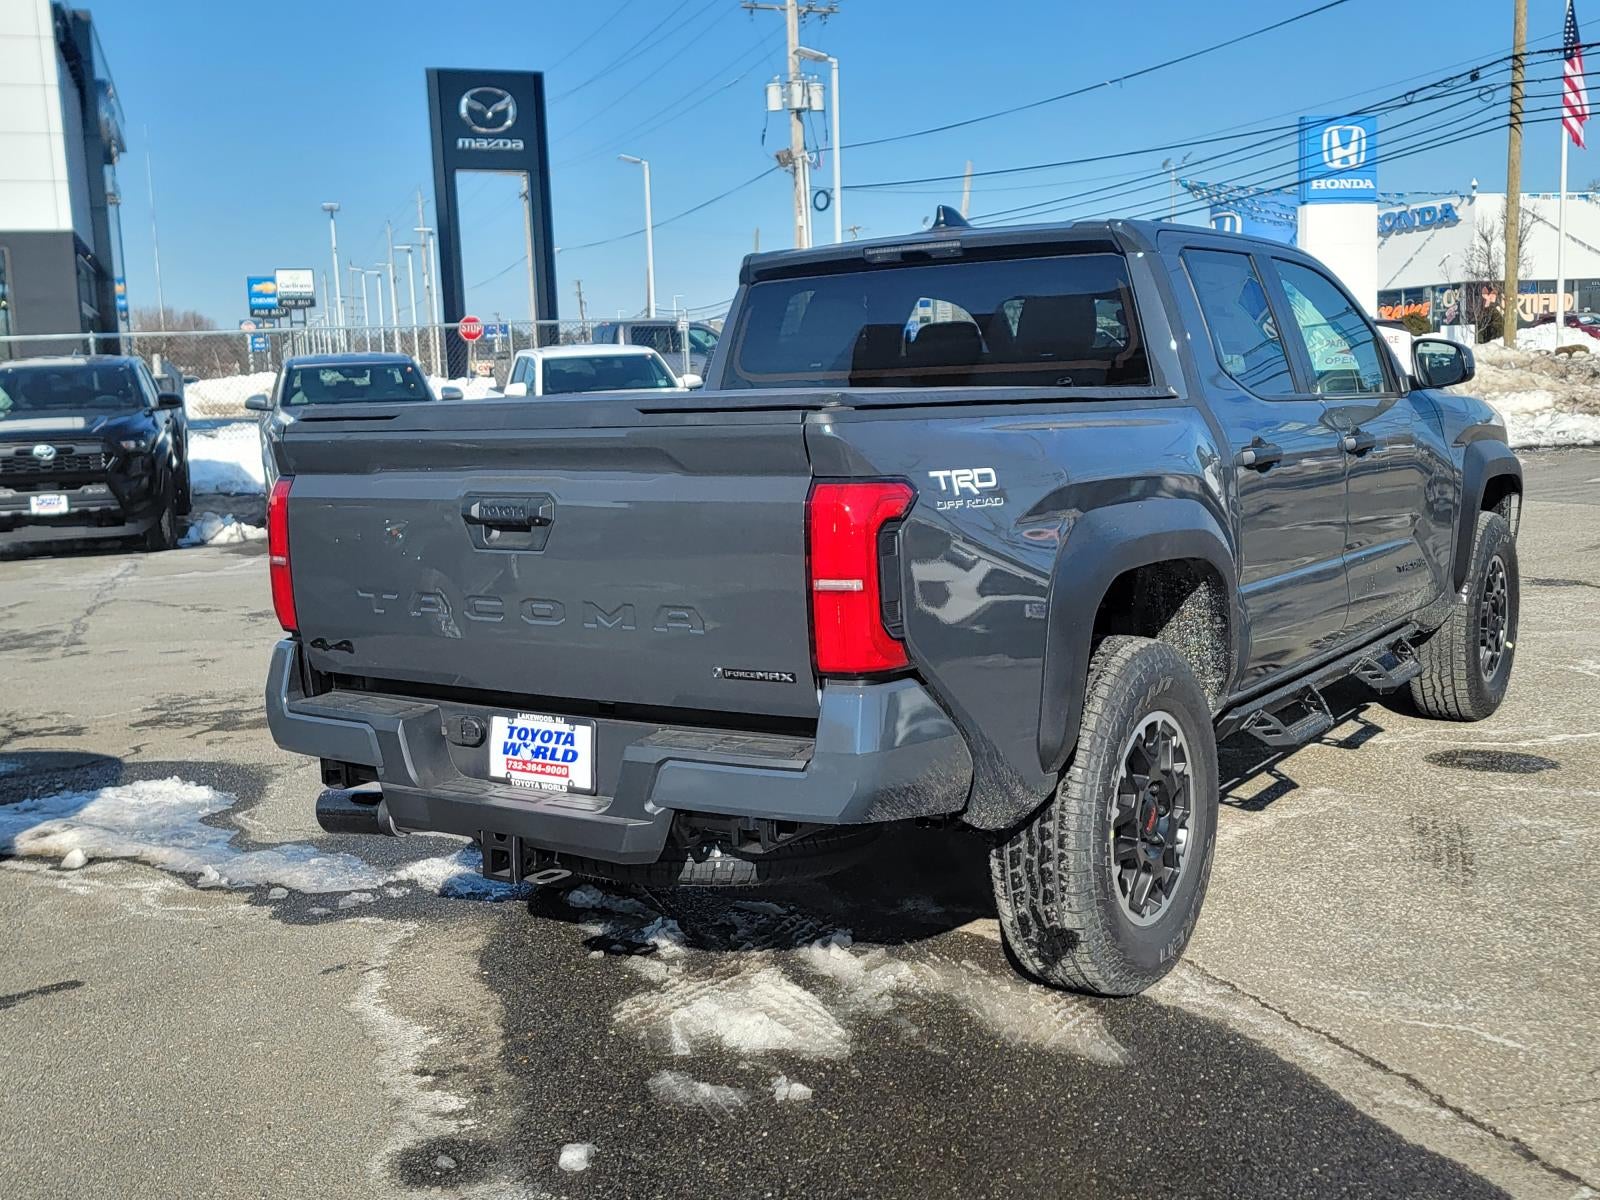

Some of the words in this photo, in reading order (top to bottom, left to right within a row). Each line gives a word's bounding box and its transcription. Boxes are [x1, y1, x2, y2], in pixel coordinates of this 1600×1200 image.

[1311, 179, 1375, 190] HONDA
[1378, 203, 1459, 236] ONDA
[461, 325, 482, 333] STOP
[1325, 356, 1355, 365] OPEN
[928, 467, 997, 496] TRD
[937, 499, 964, 510] OFF
[966, 497, 1004, 508] ROAD
[480, 505, 525, 518] TOYOTA
[357, 587, 706, 635] TACOMA
[517, 713, 554, 722] LAKEWOOD,
[507, 725, 576, 746] TOYOTA
[511, 779, 540, 789] TOYOTA
[541, 783, 568, 792] WORLD
